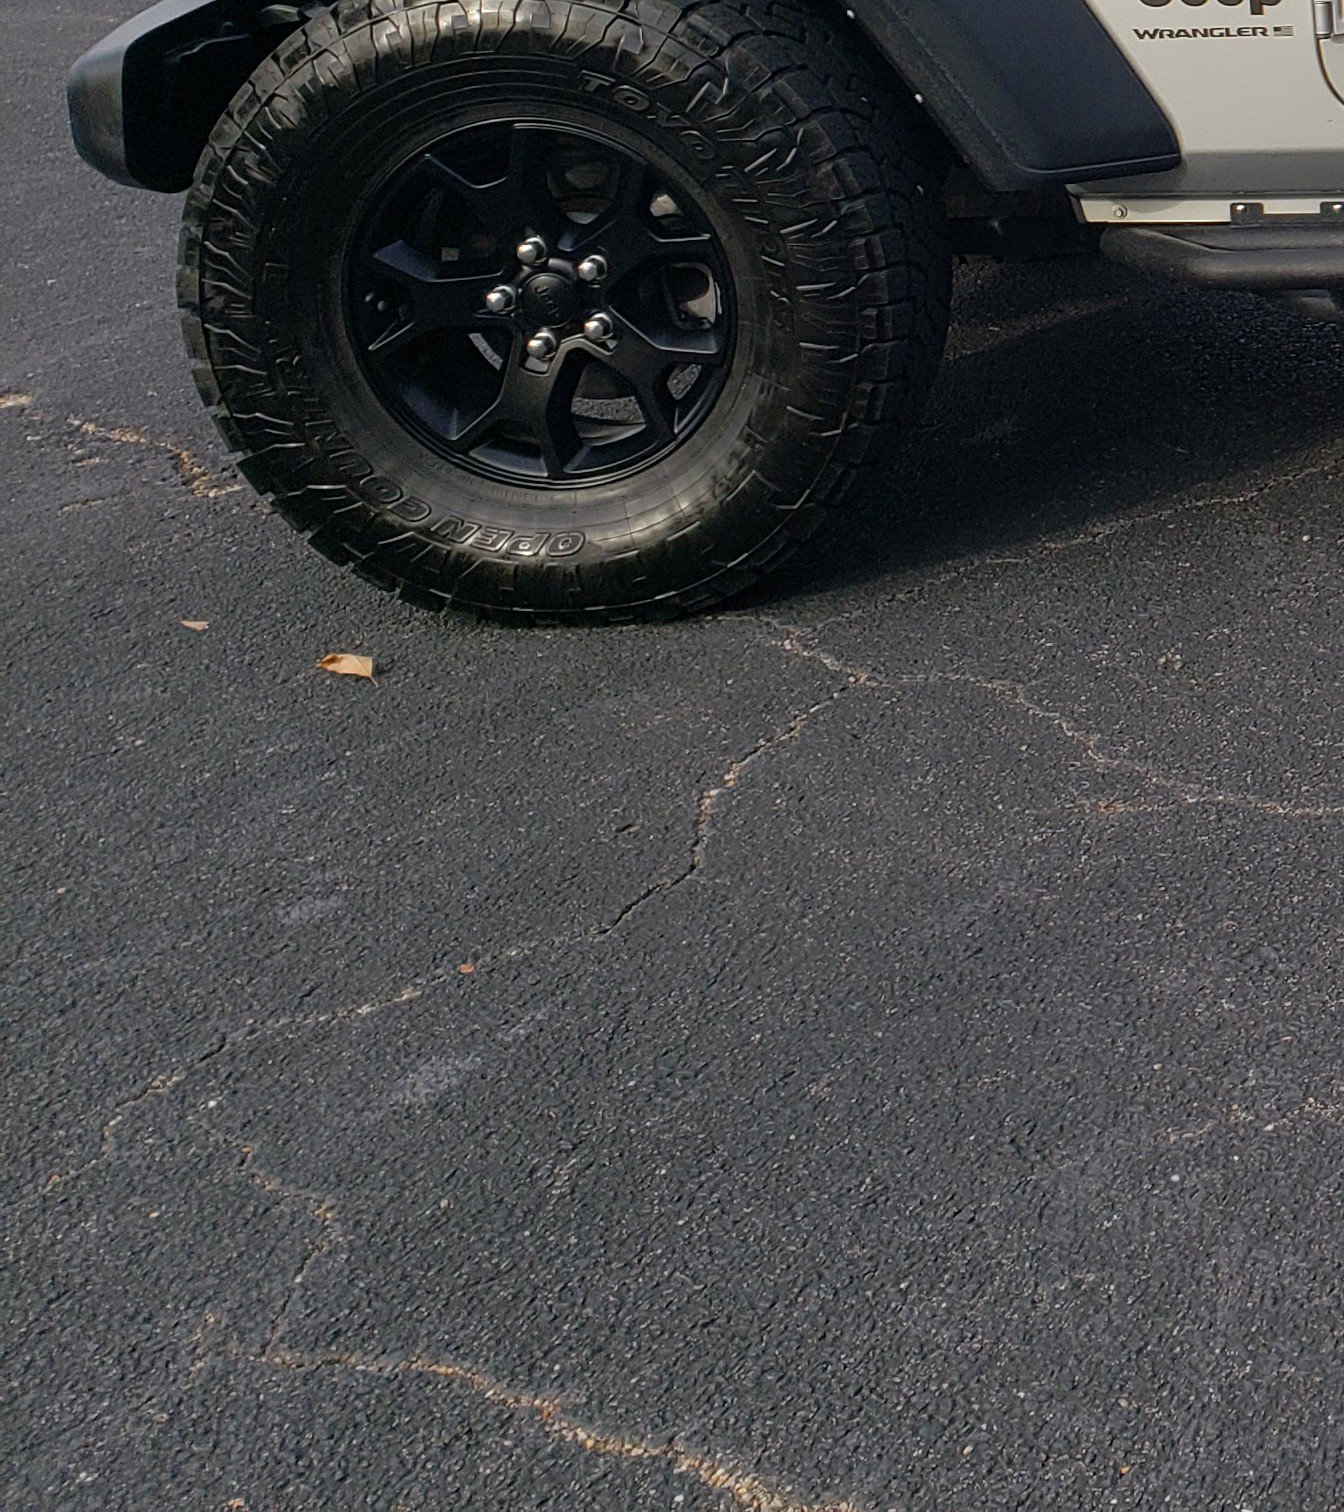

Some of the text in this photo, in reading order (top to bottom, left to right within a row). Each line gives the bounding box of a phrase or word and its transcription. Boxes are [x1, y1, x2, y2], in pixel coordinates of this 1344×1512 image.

[1133, 26, 1269, 40] WRANGLER
[577, 69, 717, 160] TOYO
[430, 514, 586, 557] OPEN
